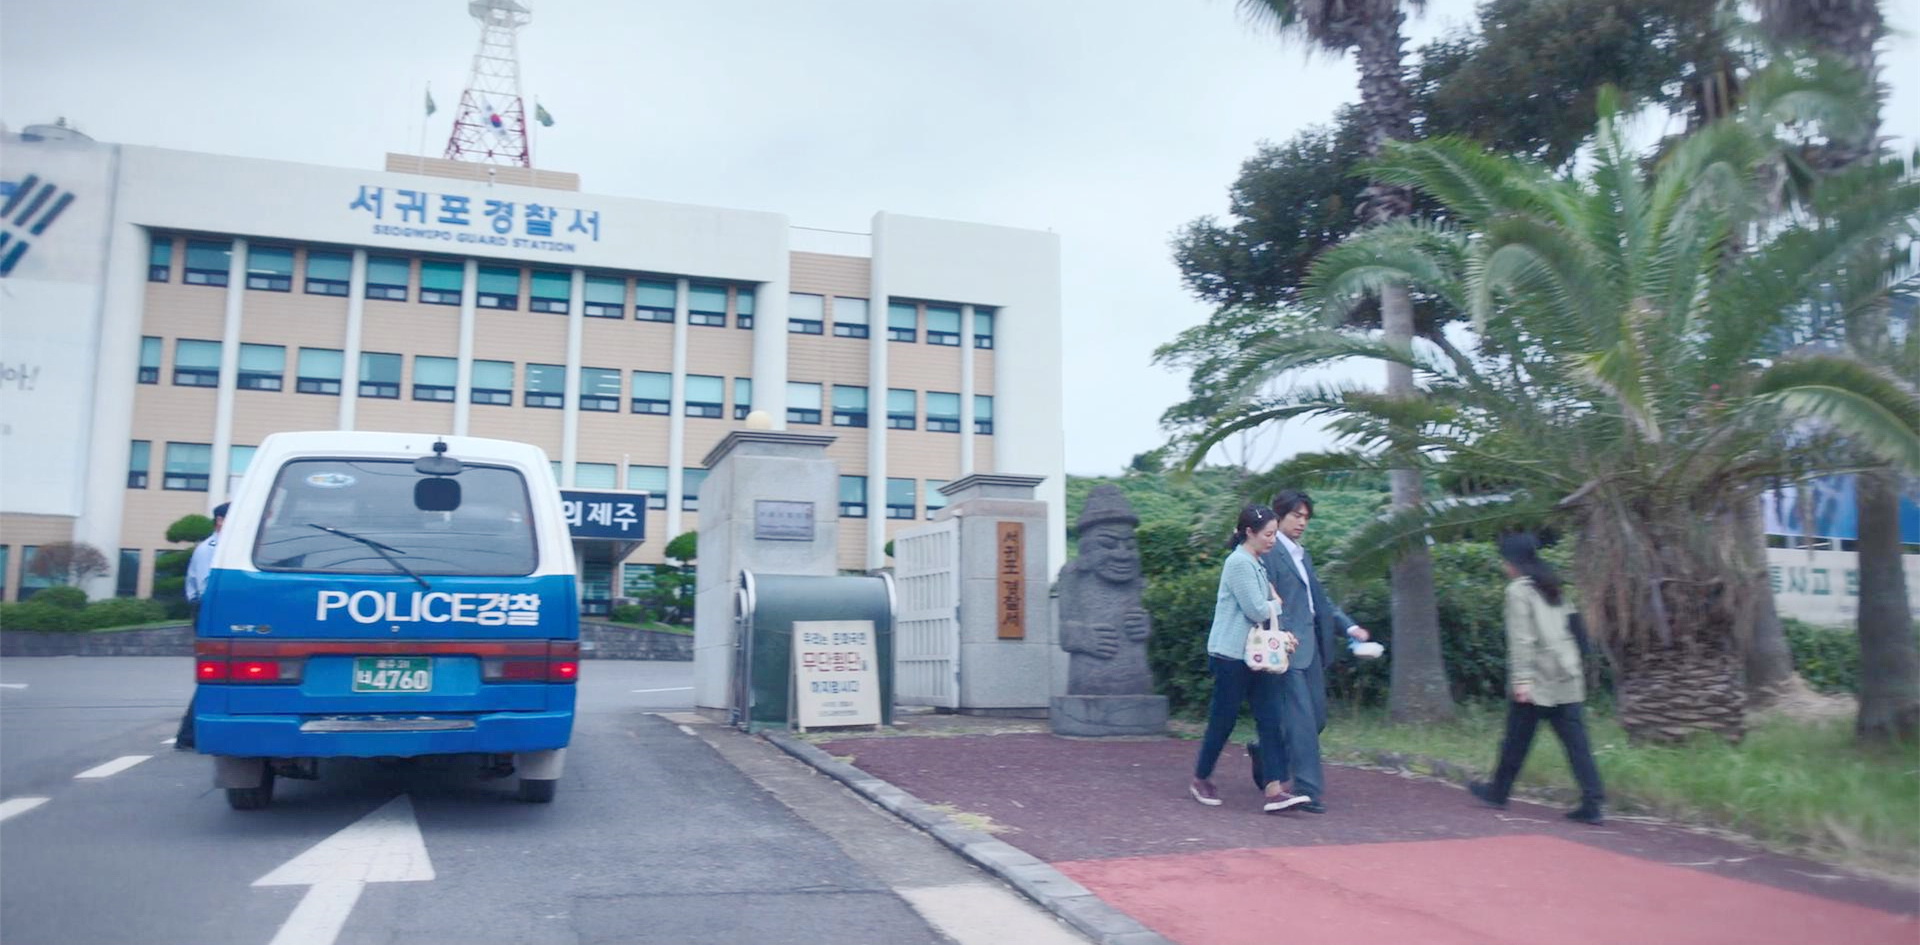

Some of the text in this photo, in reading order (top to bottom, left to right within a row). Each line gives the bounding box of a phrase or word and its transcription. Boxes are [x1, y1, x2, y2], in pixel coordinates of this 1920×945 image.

[373, 223, 576, 253] SEOGWIPO GUARD STATION
